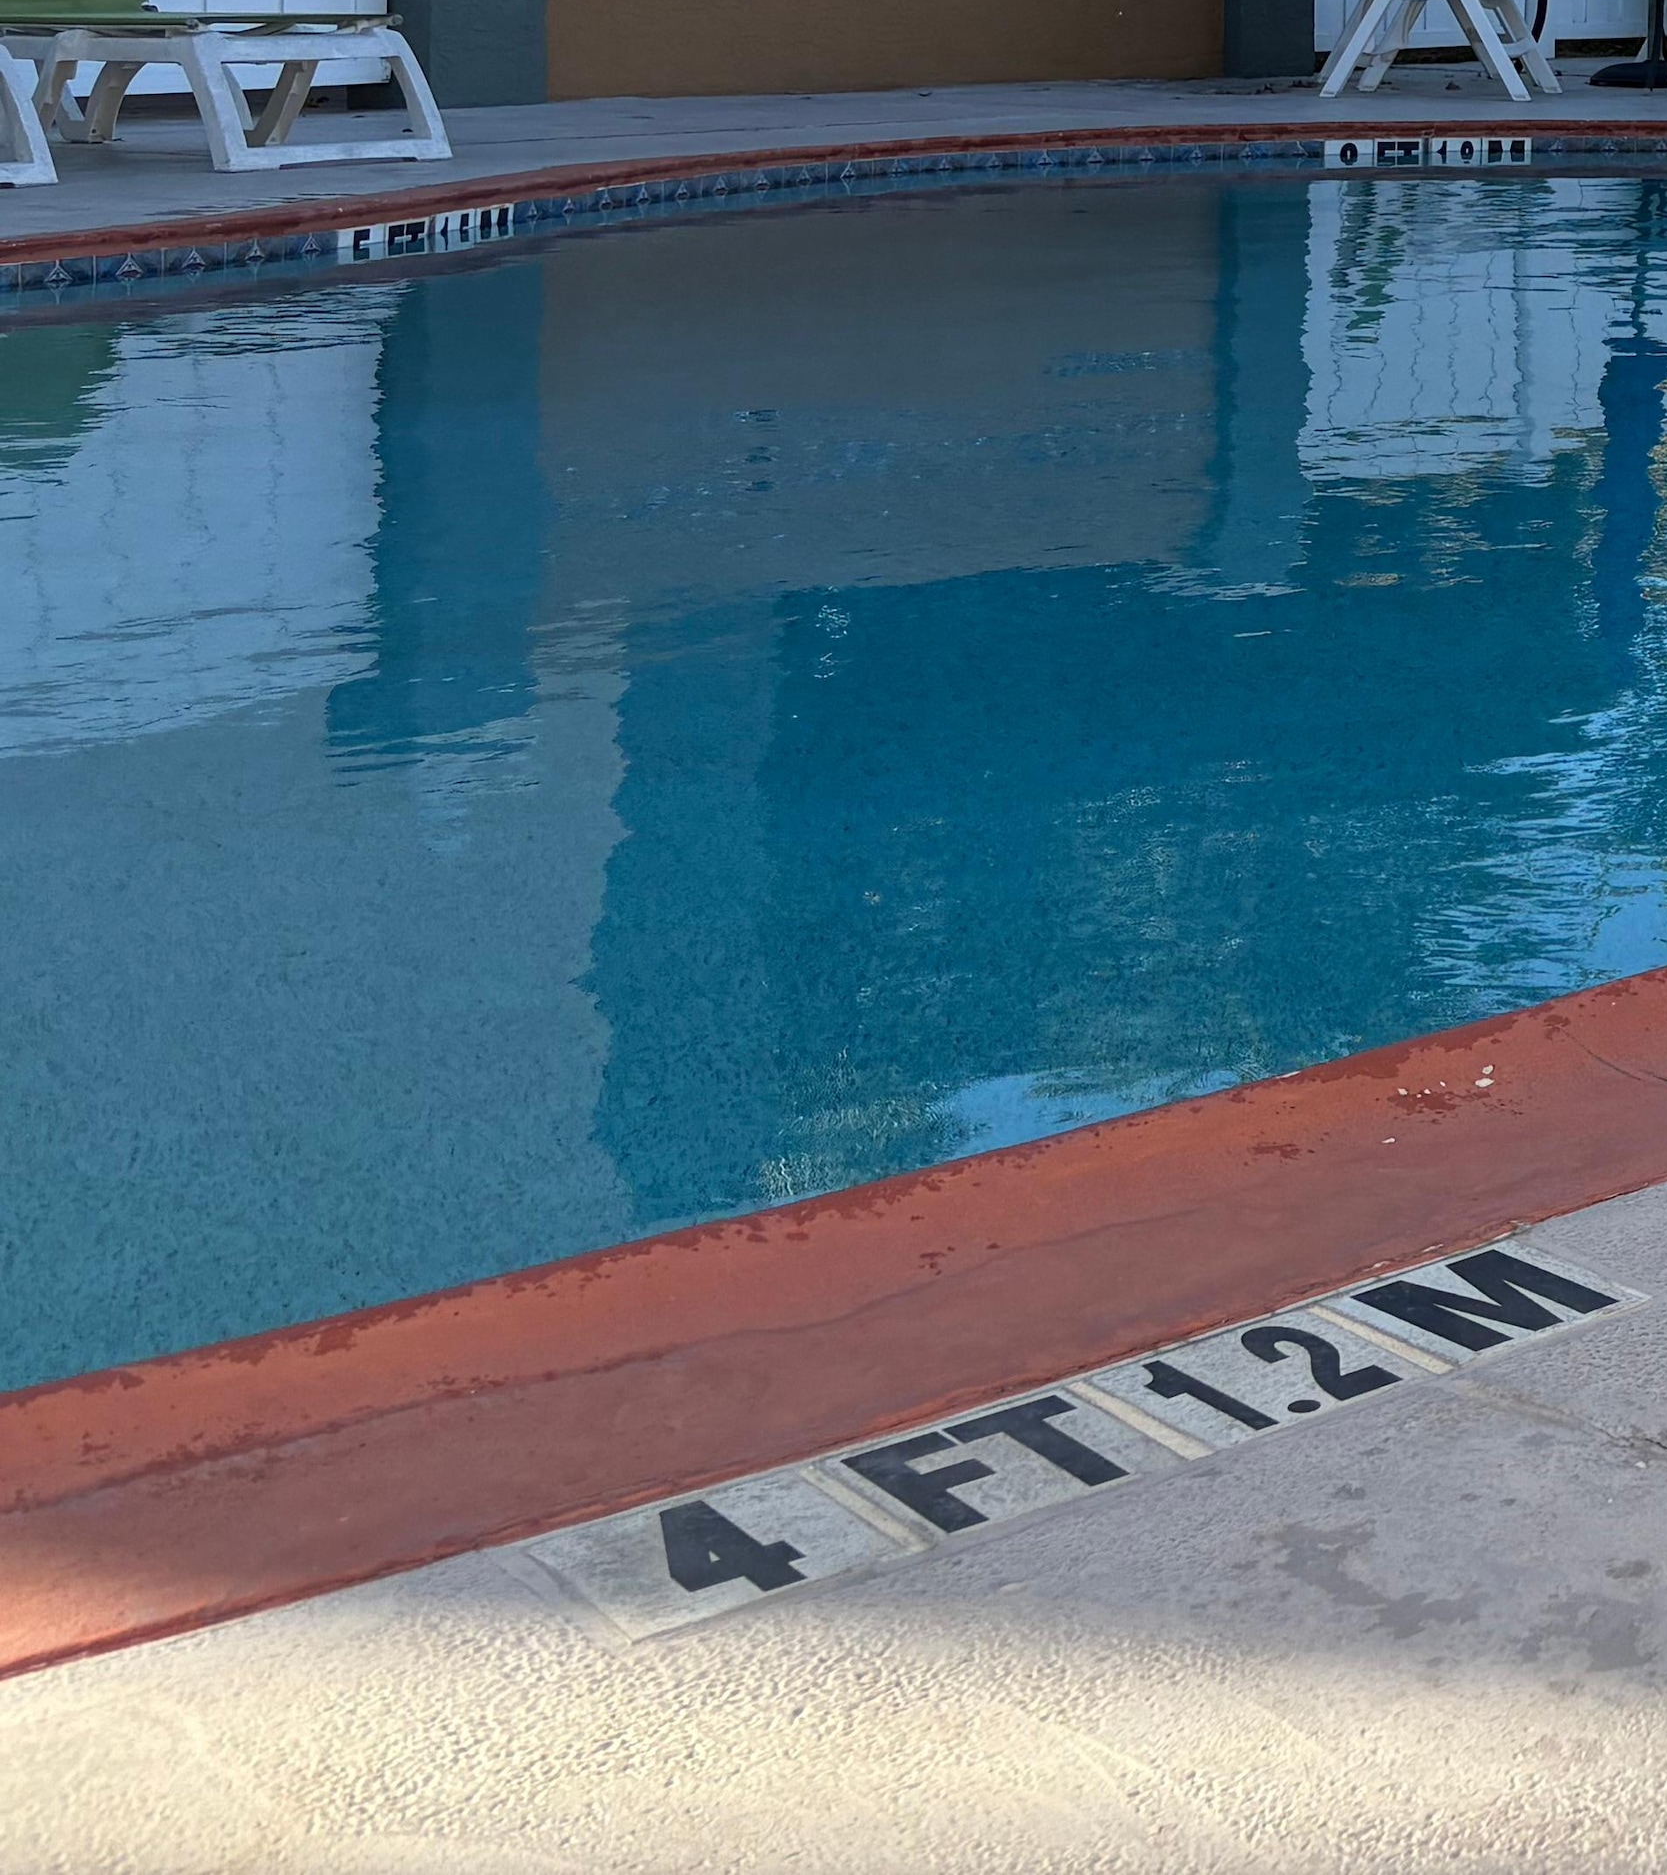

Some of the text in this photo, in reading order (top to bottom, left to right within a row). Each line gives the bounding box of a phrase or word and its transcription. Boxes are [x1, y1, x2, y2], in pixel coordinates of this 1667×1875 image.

[658, 1248, 1621, 1593] 4 FT 1.2 M
